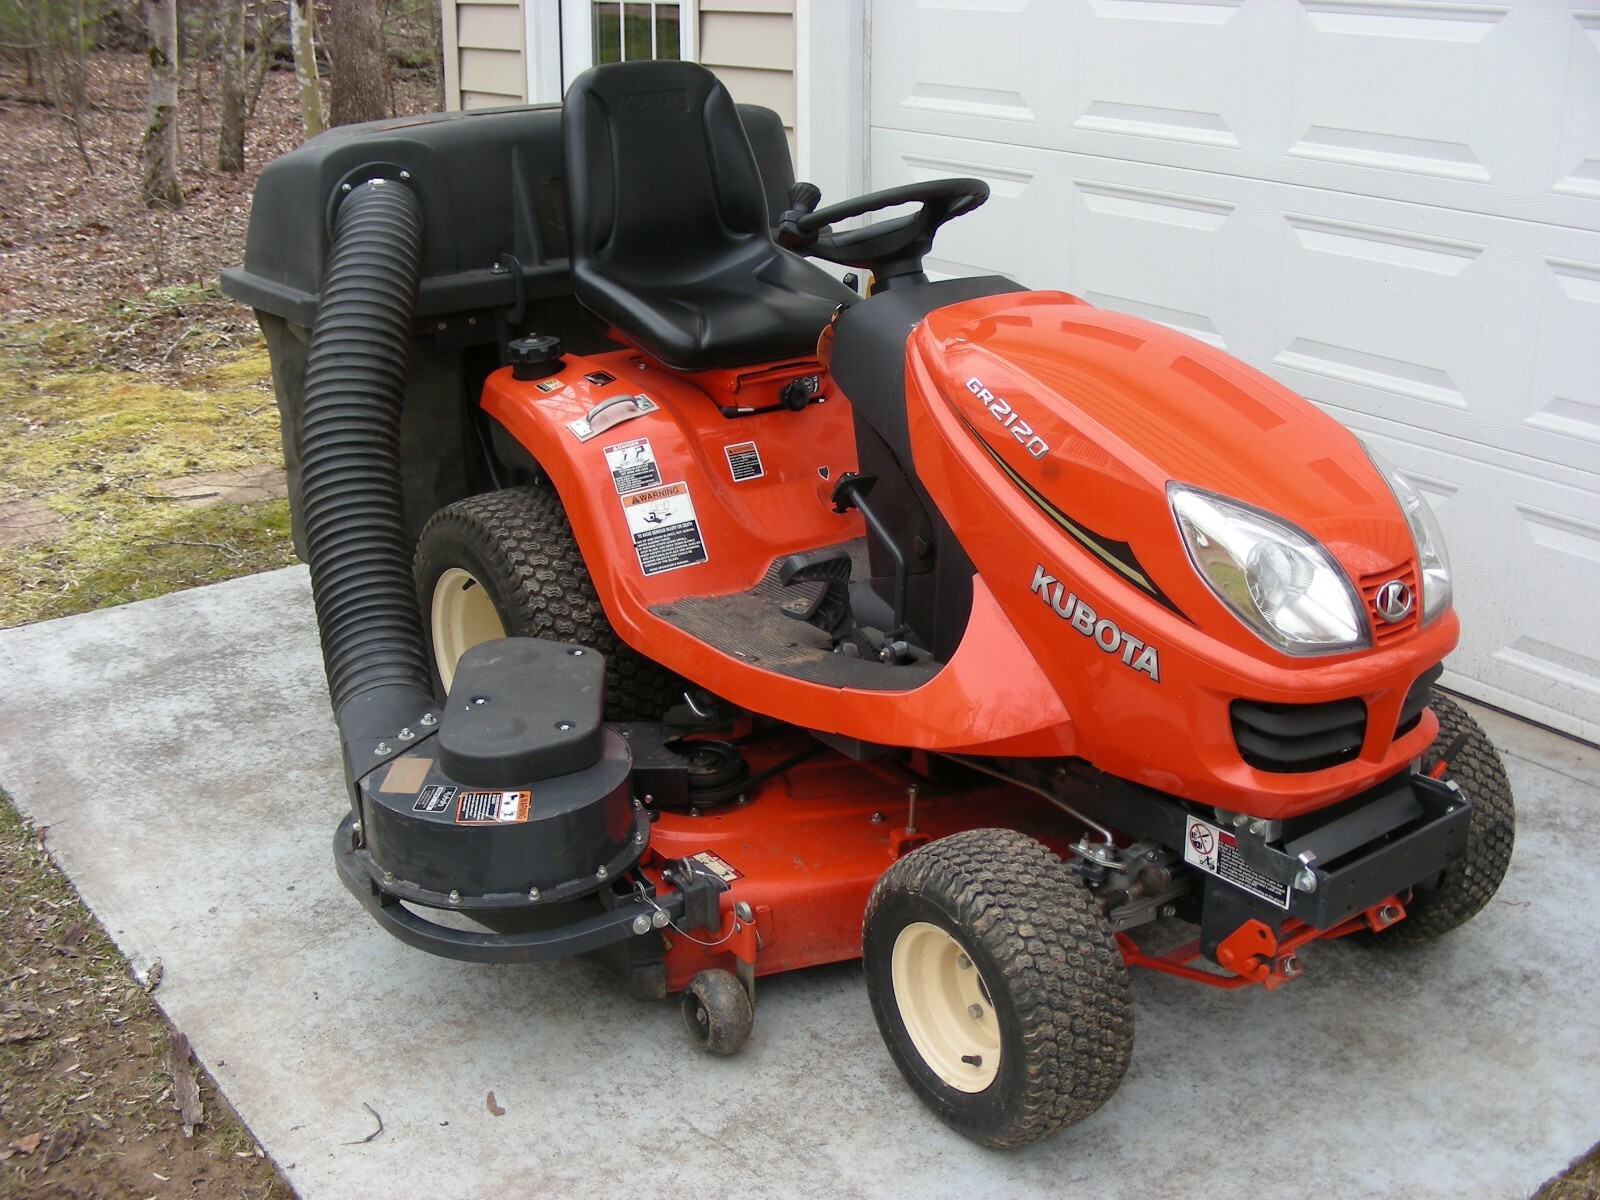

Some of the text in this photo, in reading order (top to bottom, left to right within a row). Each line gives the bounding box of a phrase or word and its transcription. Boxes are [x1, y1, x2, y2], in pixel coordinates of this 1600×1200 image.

[965, 376, 1050, 460] GR2120
[639, 486, 679, 502] WARNING
[1030, 564, 1160, 683] KUBOTA
